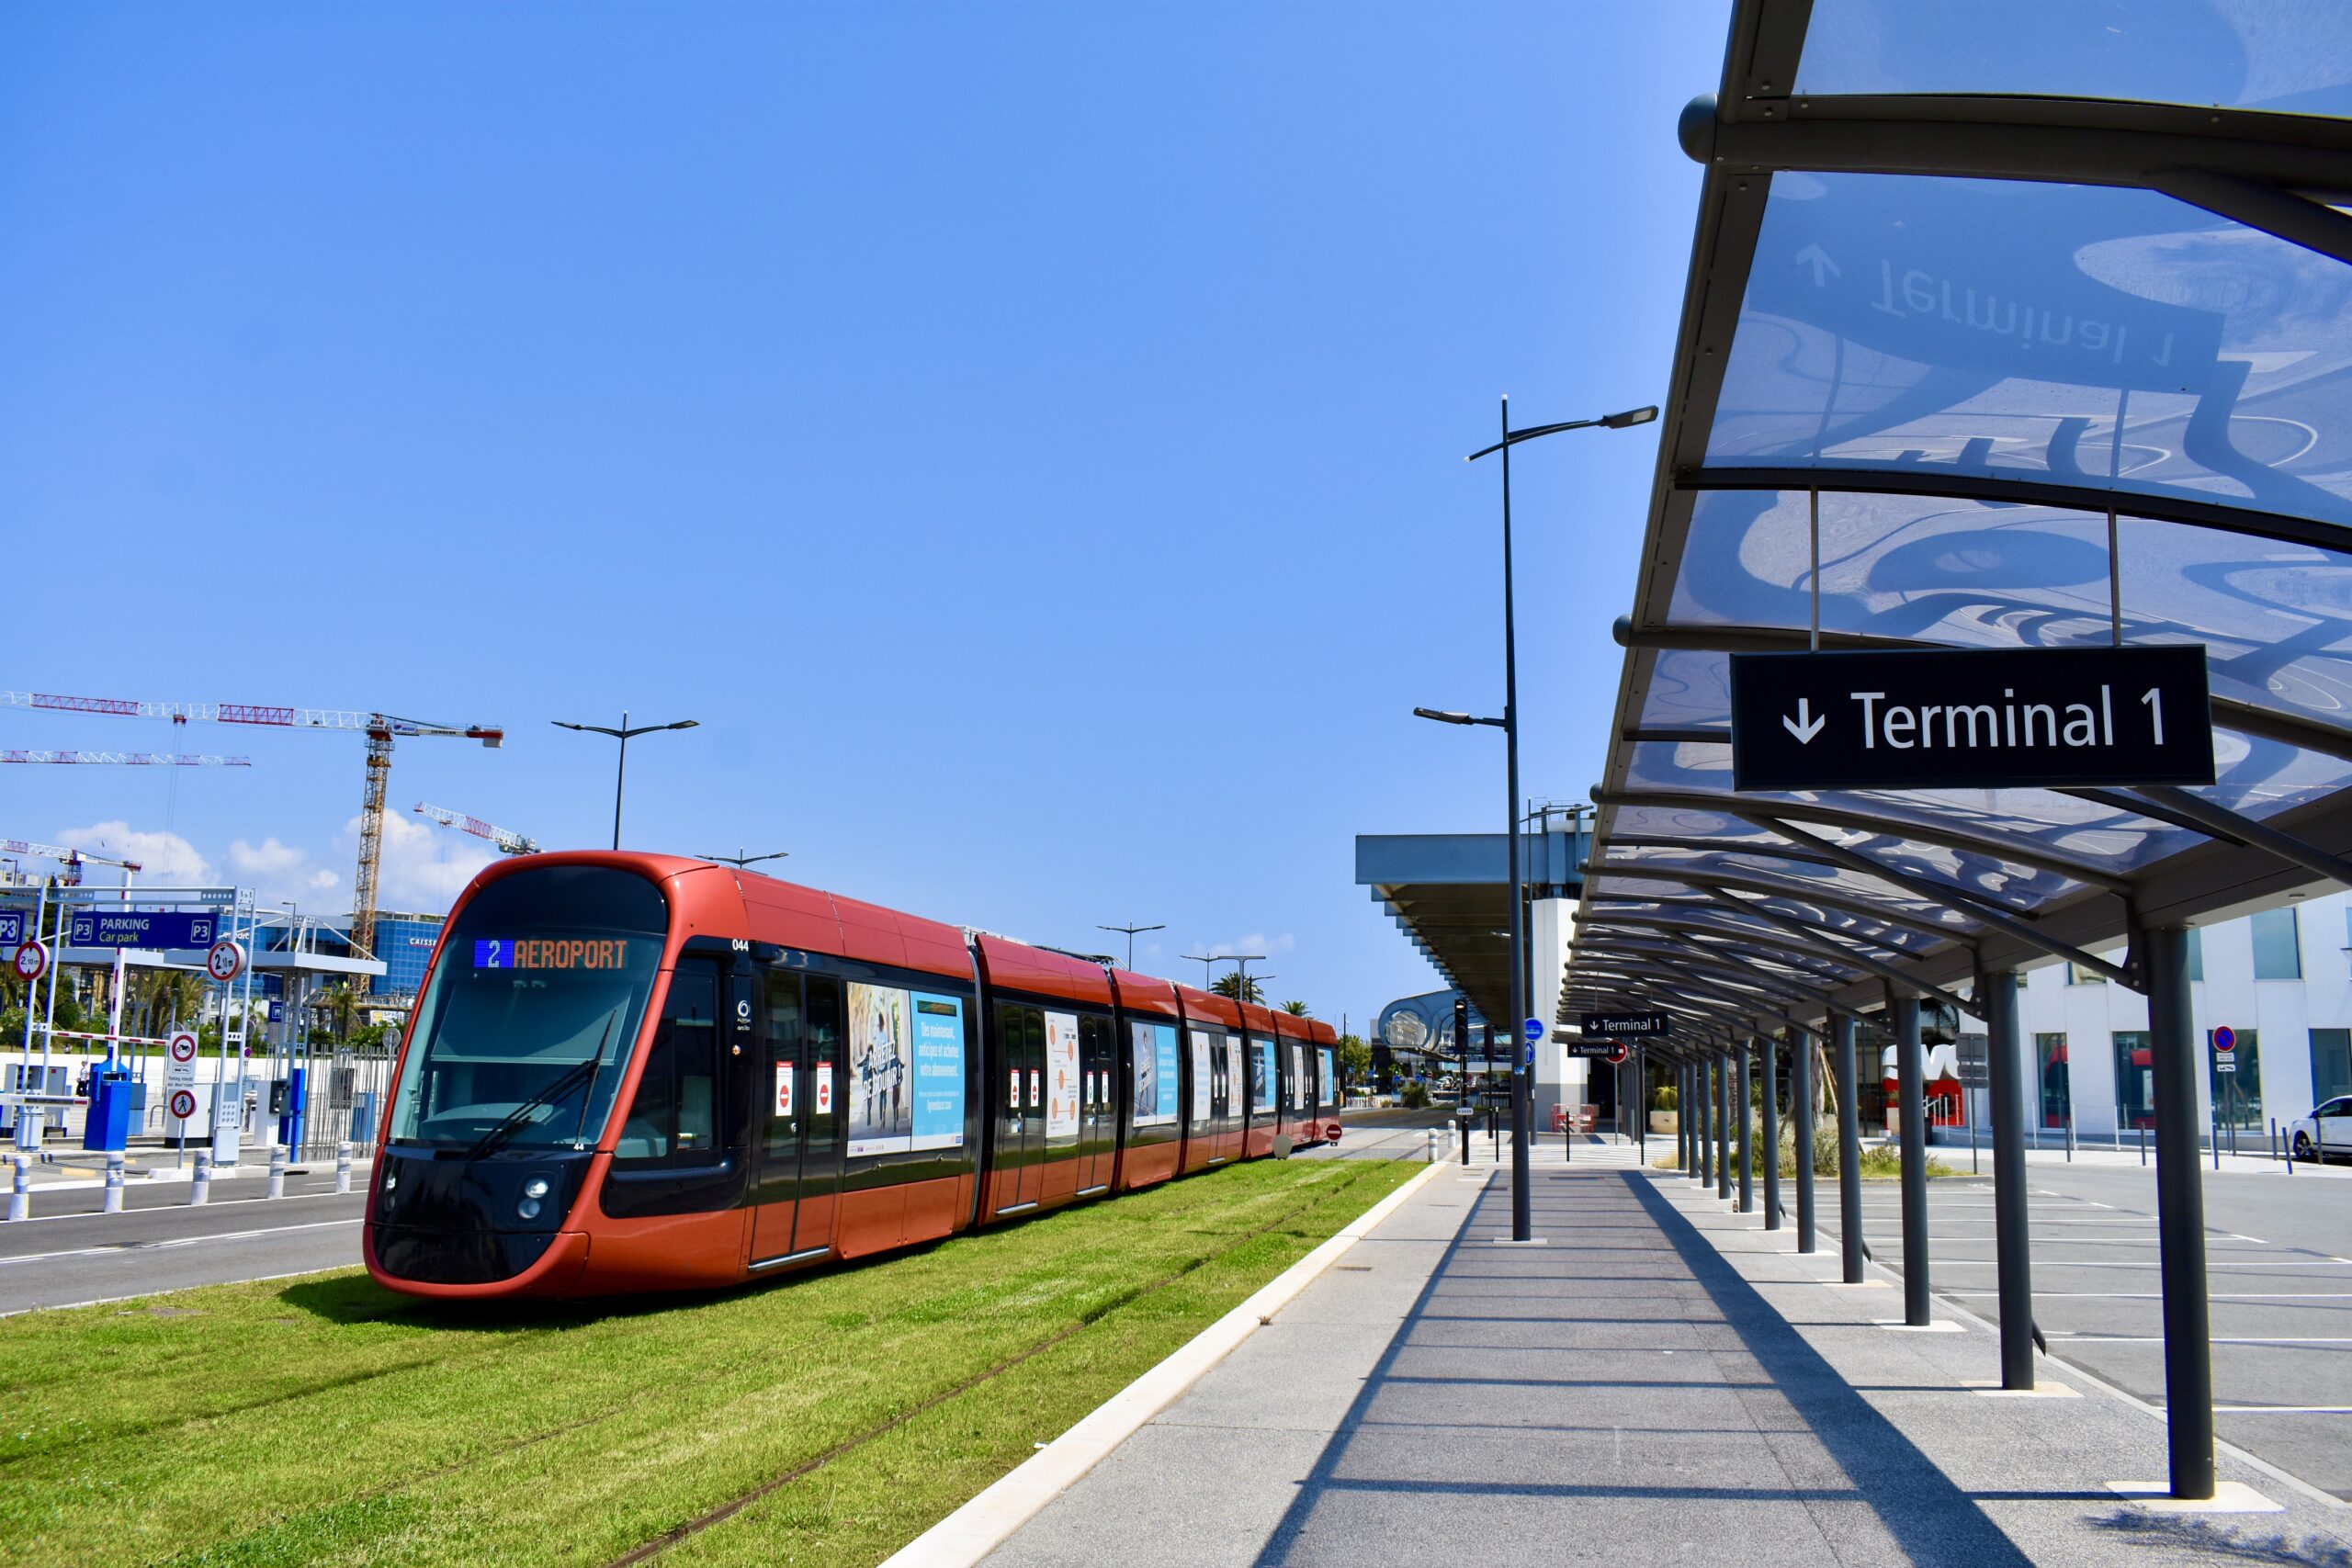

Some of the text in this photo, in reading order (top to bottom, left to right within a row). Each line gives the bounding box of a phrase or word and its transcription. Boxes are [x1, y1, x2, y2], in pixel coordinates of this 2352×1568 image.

[1850, 684, 2164, 750] Terminal 1
[0, 919, 17, 938] P3
[75, 923, 91, 936] P3
[99, 918, 150, 931] PARKING
[193, 924, 209, 938] P3
[99, 931, 139, 944] Car park
[409, 938, 438, 946] CAISSE
[731, 938, 750, 952] 044
[487, 940, 628, 969] 2 AEROPORT
[1602, 1018, 1660, 1031] Terminal 1
[1580, 1046, 1609, 1055] Terminal
[863, 1077, 872, 1102] DE
[573, 1143, 585, 1151] 44
